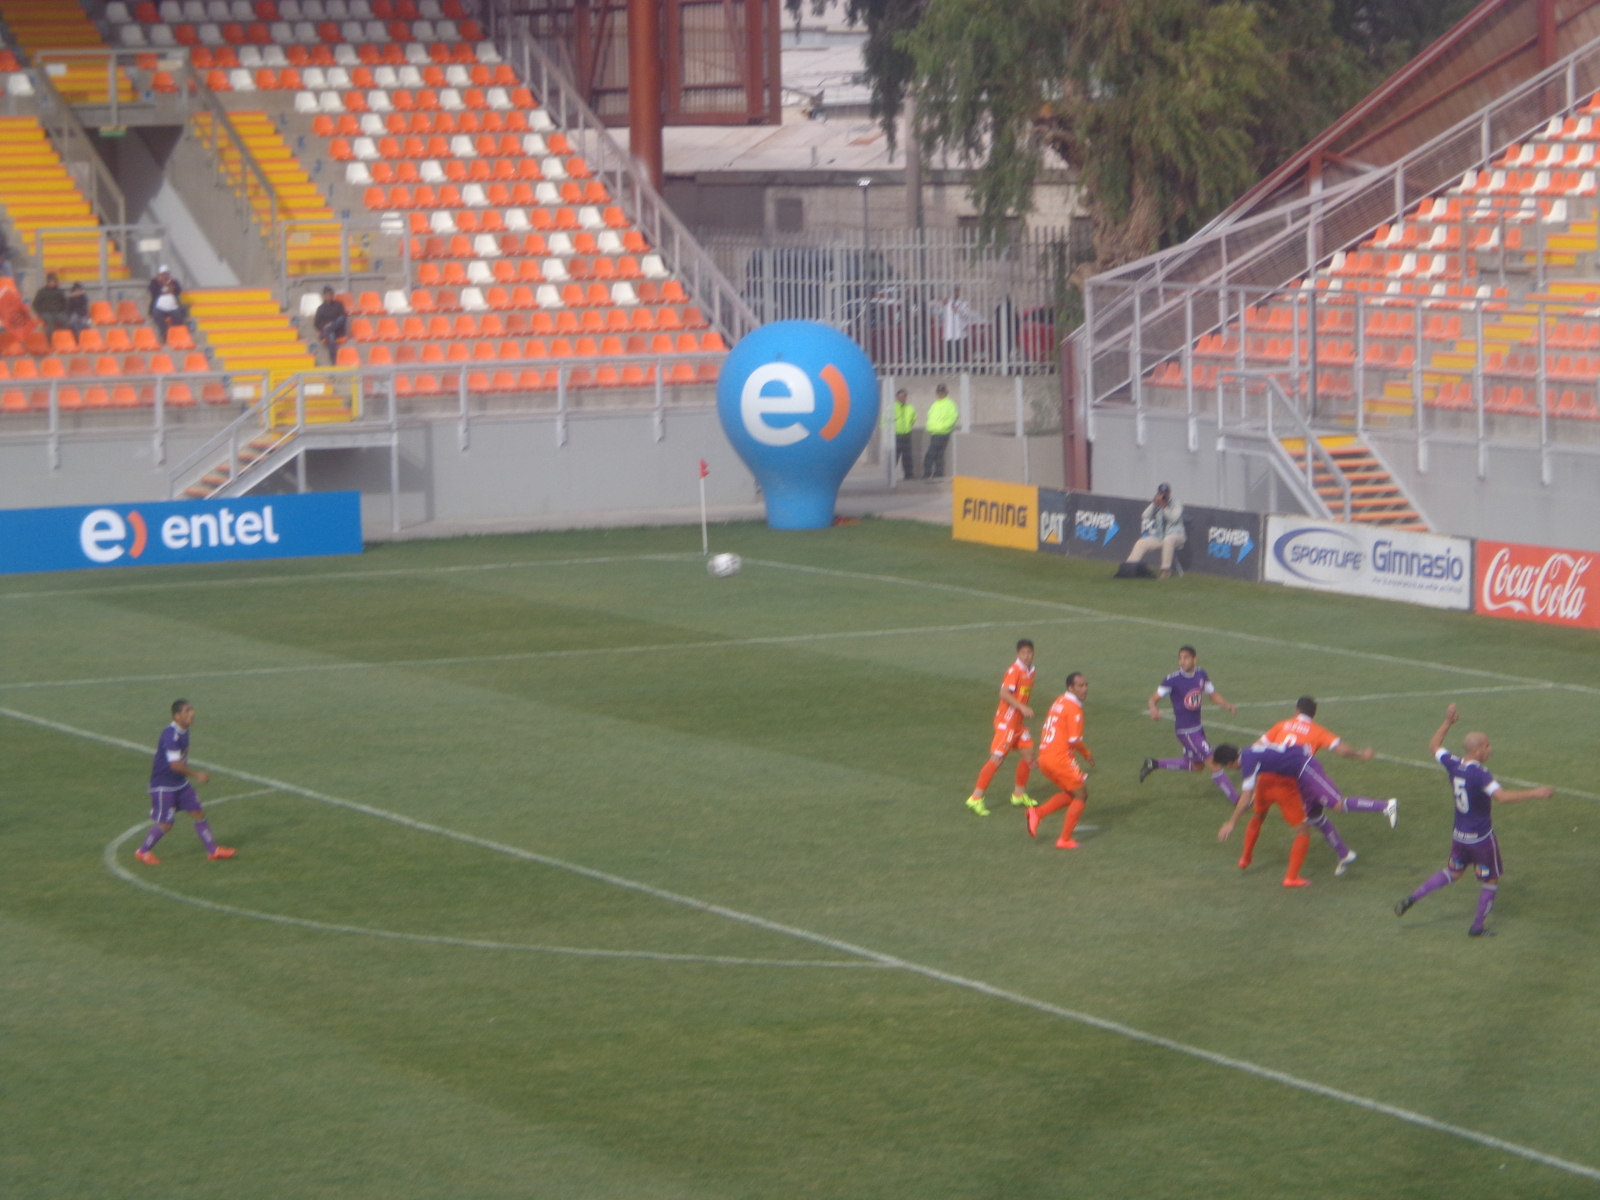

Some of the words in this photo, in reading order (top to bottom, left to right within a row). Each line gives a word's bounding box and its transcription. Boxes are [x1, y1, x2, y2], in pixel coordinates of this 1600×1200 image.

[161, 505, 280, 549] entel
[961, 497, 1028, 528] FINNING
[1040, 510, 1067, 544] CAT
[1075, 509, 1115, 530] POWER
[1208, 526, 1250, 547] POWER
[1290, 544, 1364, 571] SPORTLIFE
[1372, 538, 1464, 582] Gimnasio
[1453, 776, 1470, 814] 5
